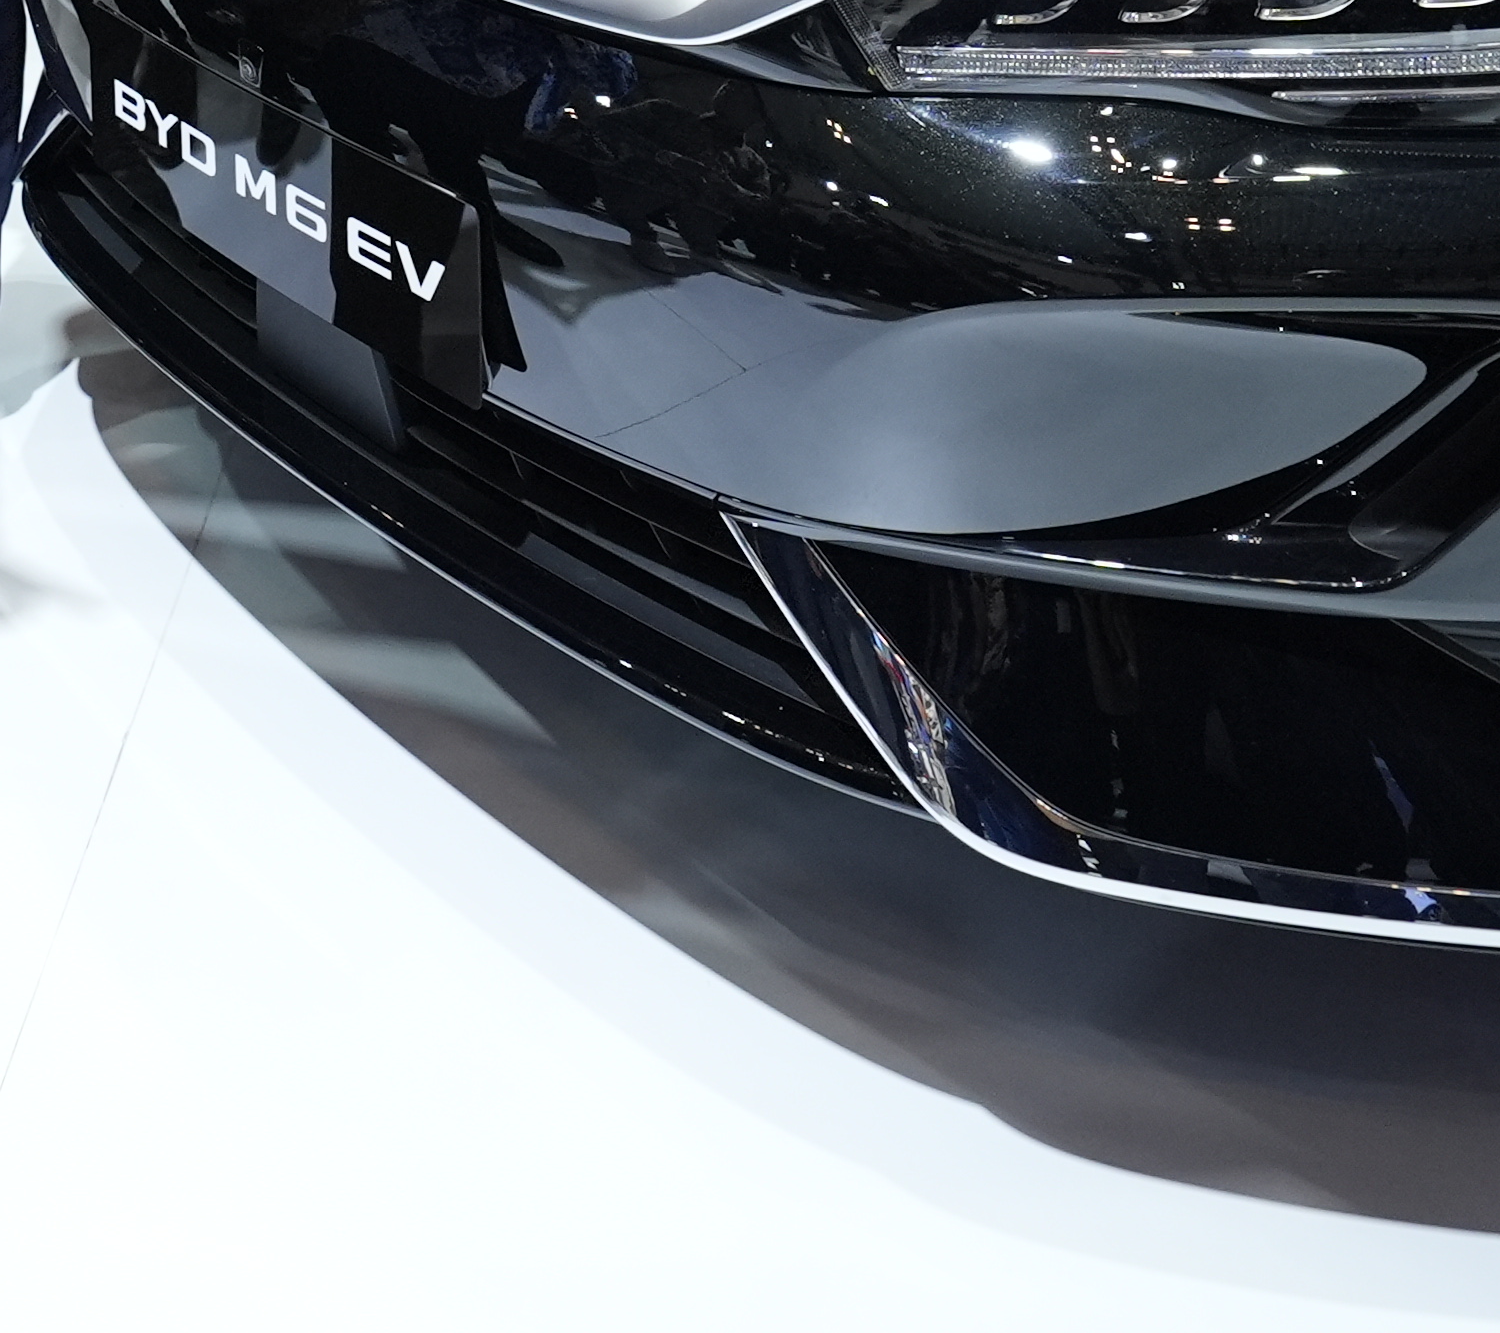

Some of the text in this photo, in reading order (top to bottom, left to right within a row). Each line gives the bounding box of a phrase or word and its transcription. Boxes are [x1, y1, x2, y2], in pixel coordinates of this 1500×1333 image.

[113, 78, 446, 303] BYD M6 EV
